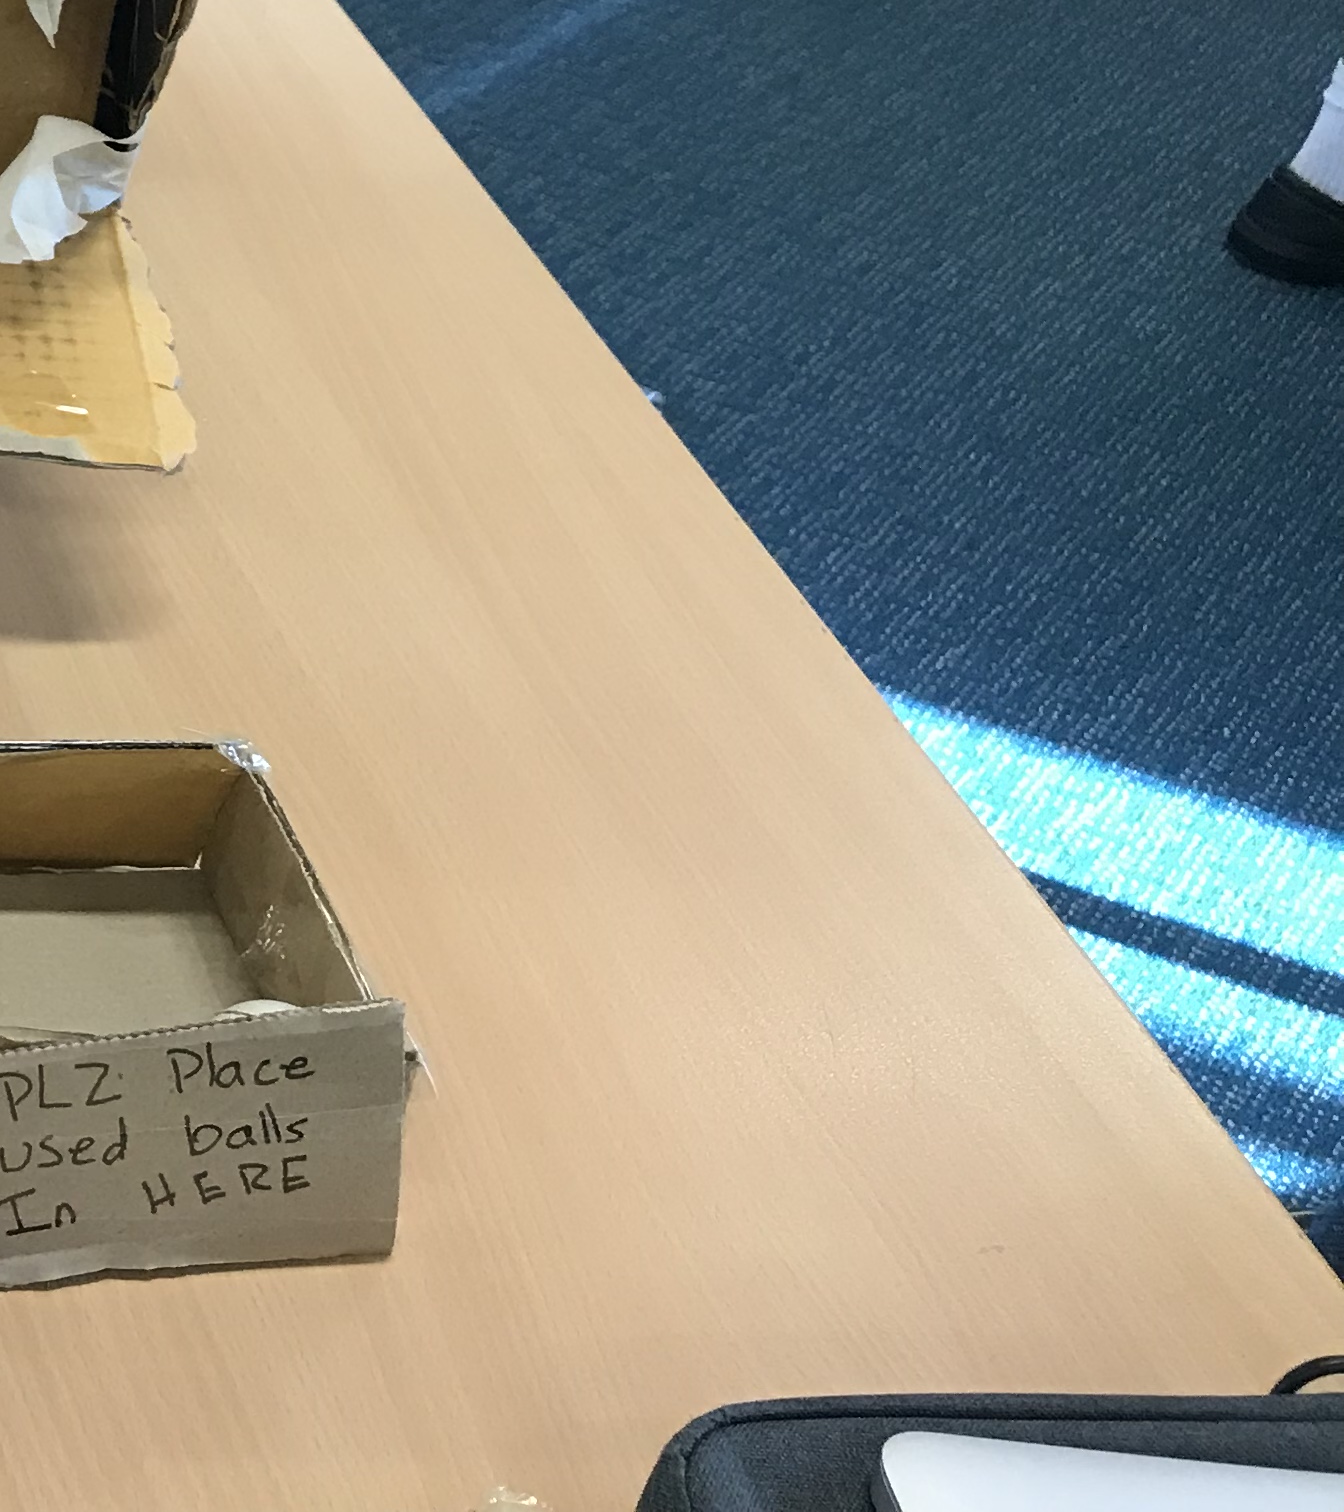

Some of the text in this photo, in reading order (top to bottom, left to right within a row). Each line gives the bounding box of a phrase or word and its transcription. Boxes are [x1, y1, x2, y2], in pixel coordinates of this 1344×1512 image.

[166, 1041, 316, 1094] Place
[184, 1102, 309, 1157] balls
[141, 1154, 311, 1215] HERE
